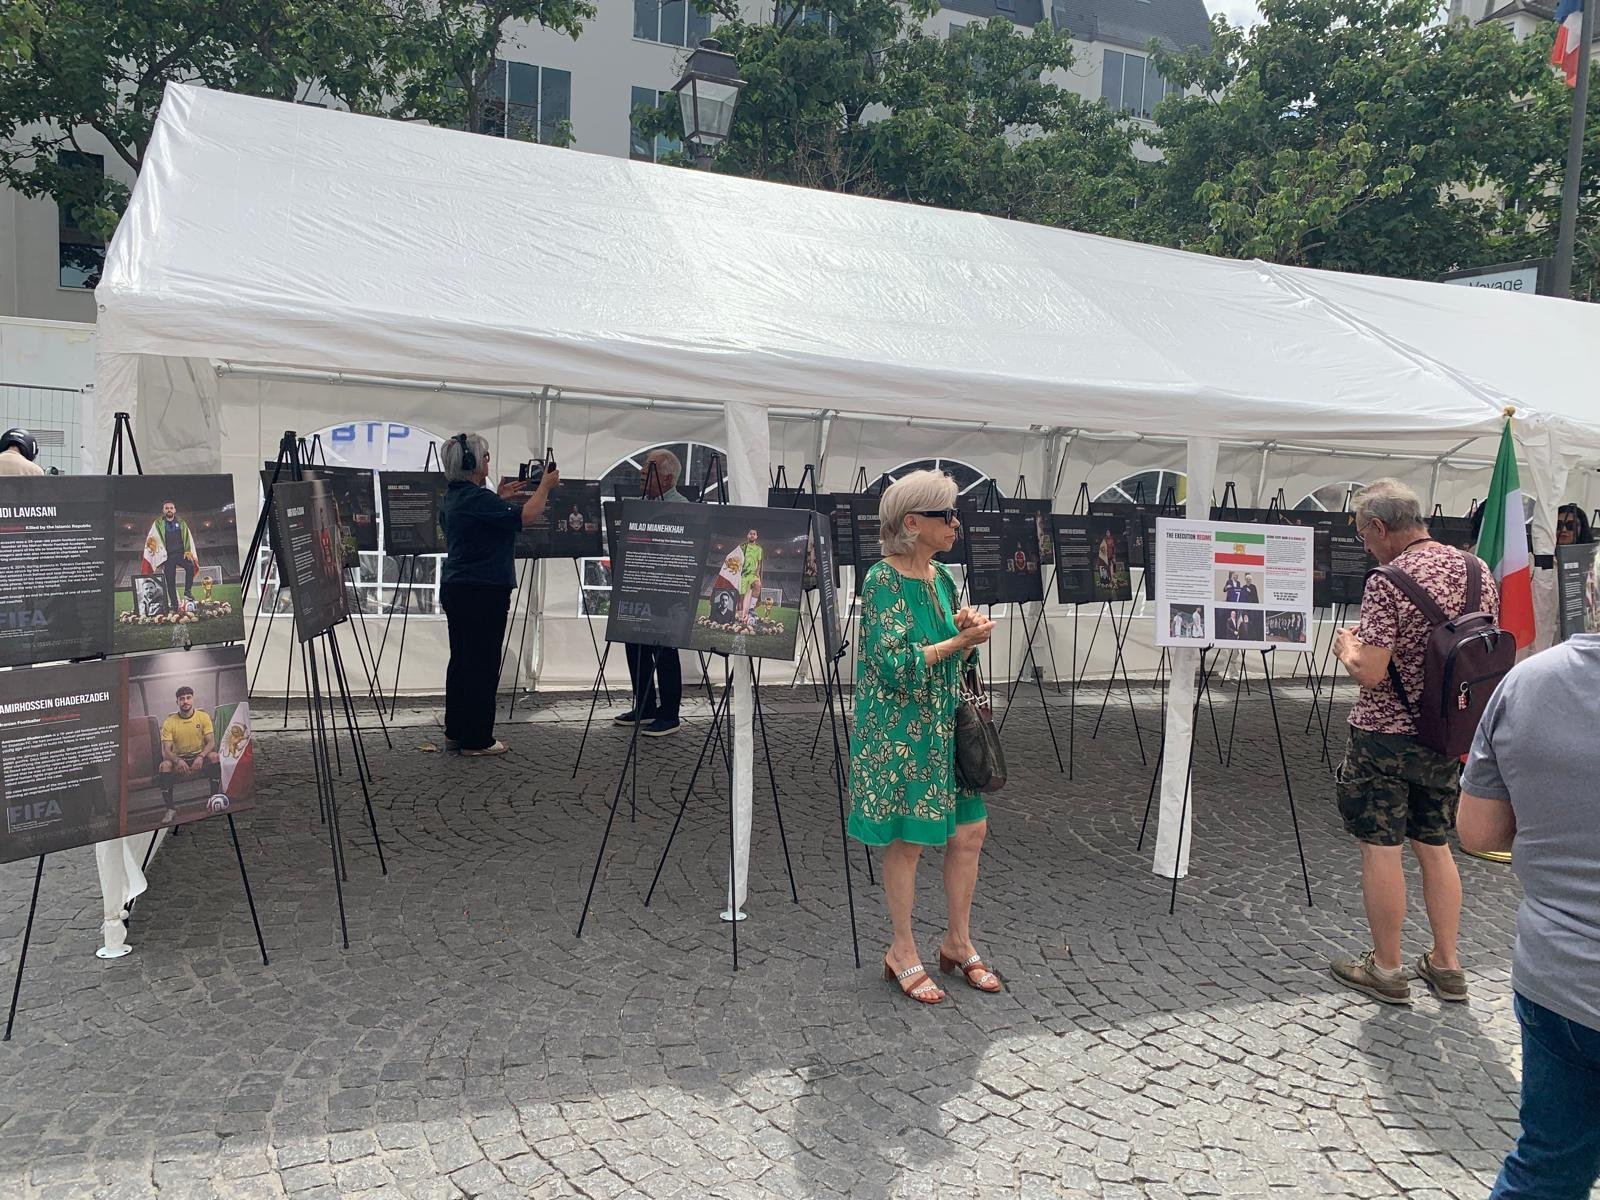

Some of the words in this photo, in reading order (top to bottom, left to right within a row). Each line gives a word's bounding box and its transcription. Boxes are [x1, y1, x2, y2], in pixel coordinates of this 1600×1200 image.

[0, 507, 11, 517] DI
[14, 506, 56, 517] LAVASANI
[629, 522, 646, 531] MILAD
[1175, 532, 1196, 540] EXECUTION
[1197, 533, 1212, 541] REGIME
[1235, 592, 1241, 602] 7
[620, 600, 652, 616] FIFA
[0, 699, 53, 714] AMIRHOSSEIN
[55, 692, 110, 707] GHADERZADEH
[10, 800, 62, 823] FIFA
